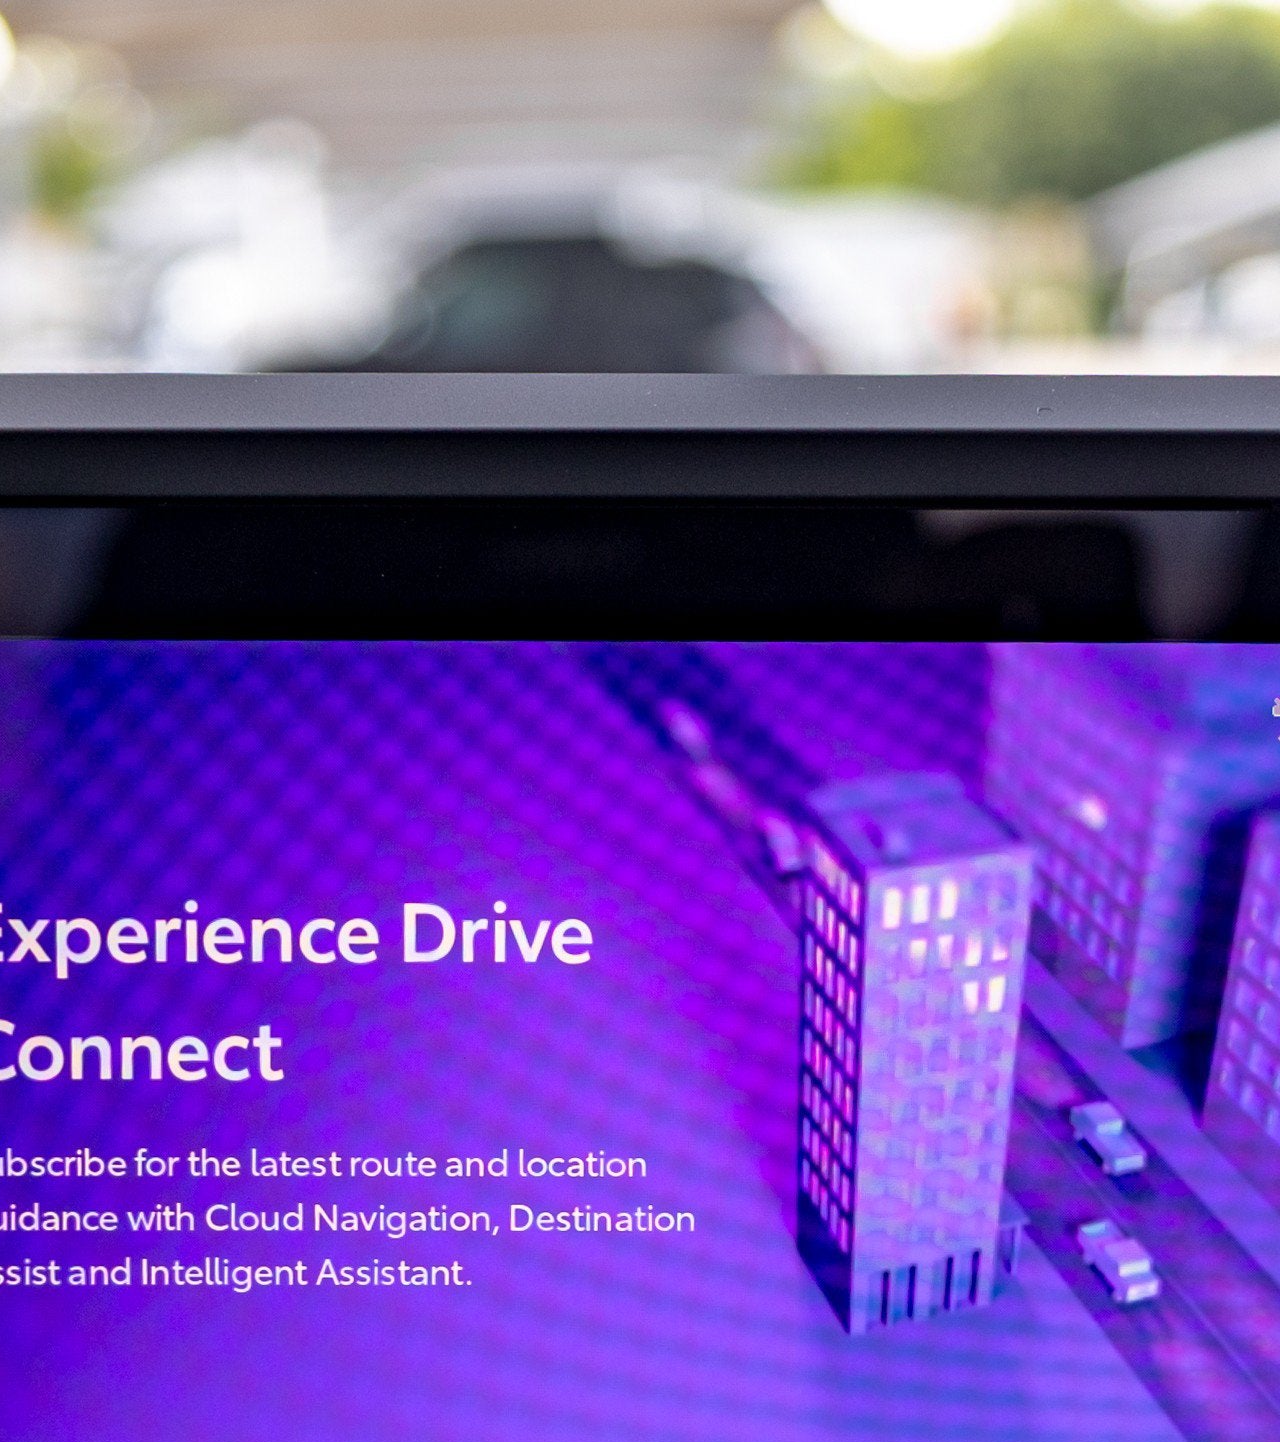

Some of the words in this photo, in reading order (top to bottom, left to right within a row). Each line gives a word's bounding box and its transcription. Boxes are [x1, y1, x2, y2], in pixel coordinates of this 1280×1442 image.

[403, 901, 593, 964] Drive
[134, 1148, 179, 1178] for
[188, 1148, 240, 1178] the
[250, 1148, 341, 1178] latest
[348, 1151, 436, 1178] route
[445, 1148, 508, 1178] and
[517, 1148, 647, 1178] location
[126, 1203, 195, 1233] with
[205, 1203, 304, 1233] Cloud
[313, 1203, 500, 1240] Navigation,
[509, 1203, 695, 1233] Destination
[69, 1257, 131, 1287] and
[140, 1257, 308, 1295] Intelligent
[316, 1257, 472, 1287] Assistant.
